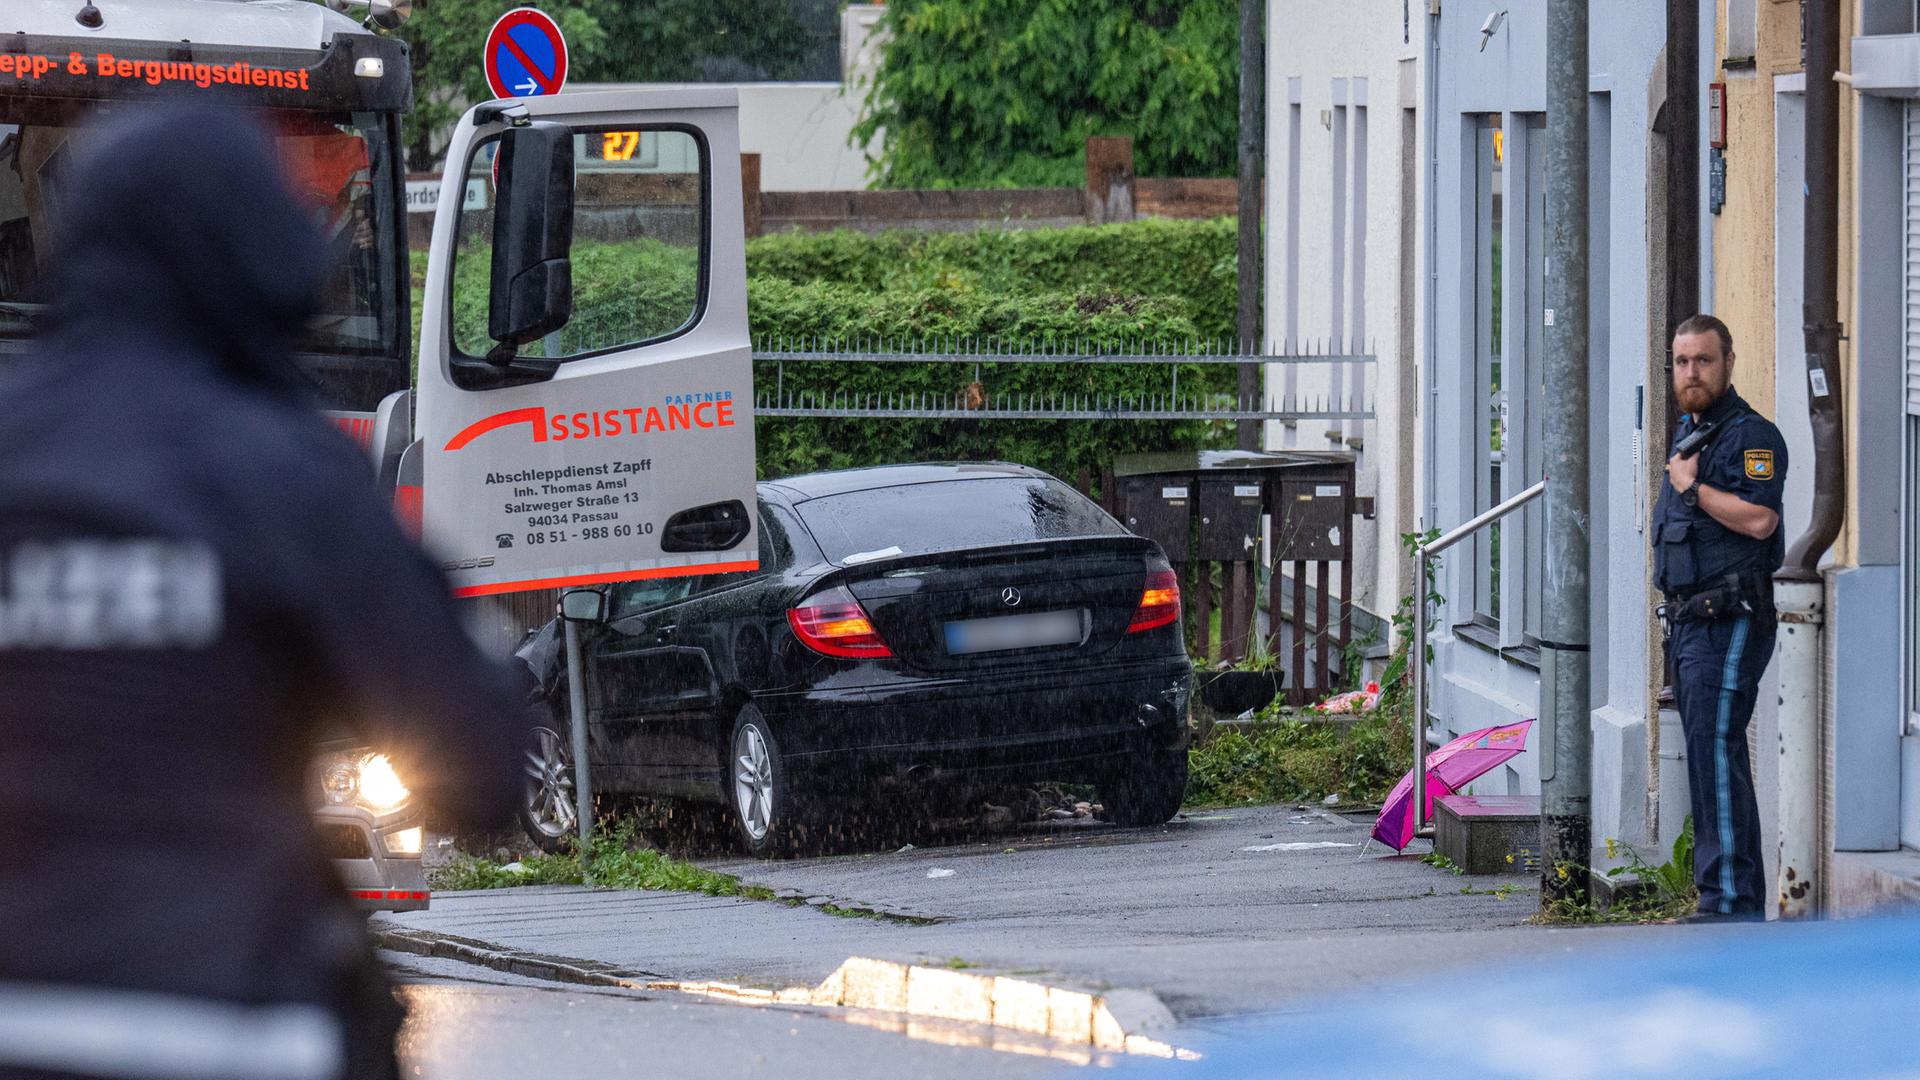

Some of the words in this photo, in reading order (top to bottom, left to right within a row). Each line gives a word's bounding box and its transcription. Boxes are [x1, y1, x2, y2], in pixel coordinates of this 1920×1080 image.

[0, 54, 58, 79] epp-
[67, 51, 87, 75] &
[97, 53, 309, 91] Bergungsdienst
[603, 131, 639, 160] 27
[666, 391, 732, 405] PARTNER
[485, 464, 609, 485] Abschleppdienst
[613, 459, 652, 476] Zapff
[514, 487, 538, 498] Inh.
[542, 481, 592, 496] Thomas
[596, 478, 627, 490] Amsl
[504, 500, 572, 515] Salzweger
[577, 495, 619, 509] Straße
[624, 492, 639, 504] 13
[528, 516, 568, 528] 94034
[572, 511, 619, 524] Passau
[527, 533, 545, 546] 08
[550, 531, 566, 544] 51
[582, 528, 609, 542] 988
[614, 526, 632, 539] 60
[637, 523, 653, 536] 10
